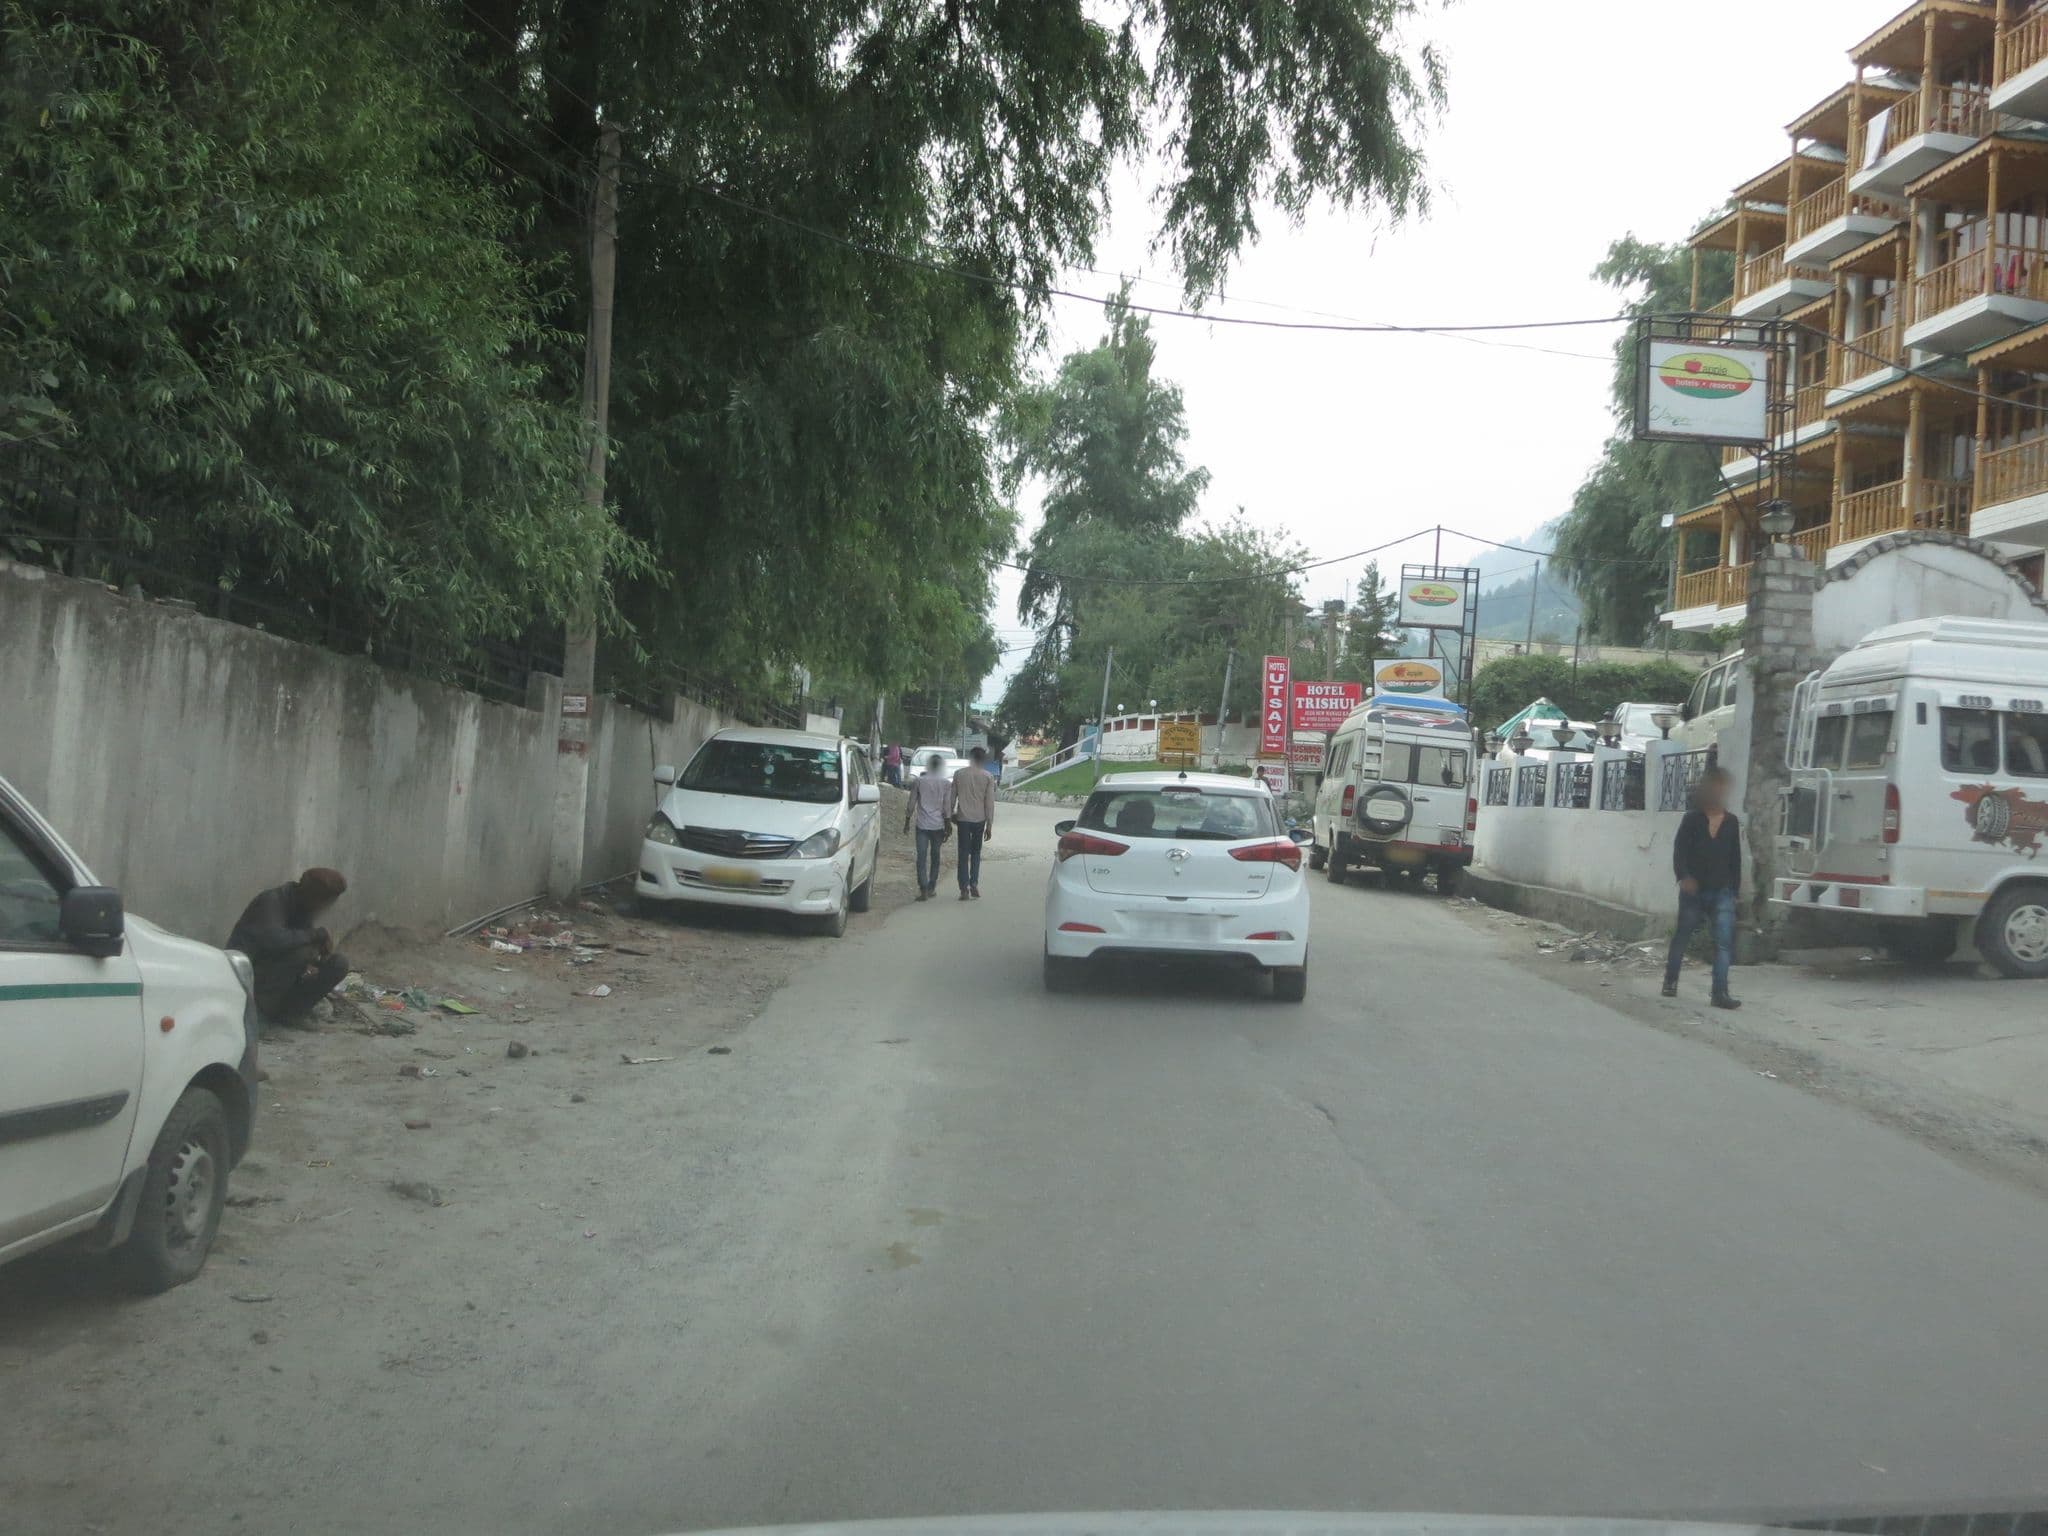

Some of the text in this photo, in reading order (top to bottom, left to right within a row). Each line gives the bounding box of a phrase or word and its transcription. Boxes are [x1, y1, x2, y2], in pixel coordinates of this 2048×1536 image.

[1268, 663, 1287, 671] HOTEL
[1307, 685, 1345, 696] HOTEL
[1268, 673, 1285, 734] UTSAV
[1295, 697, 1356, 710] TRISHUL
